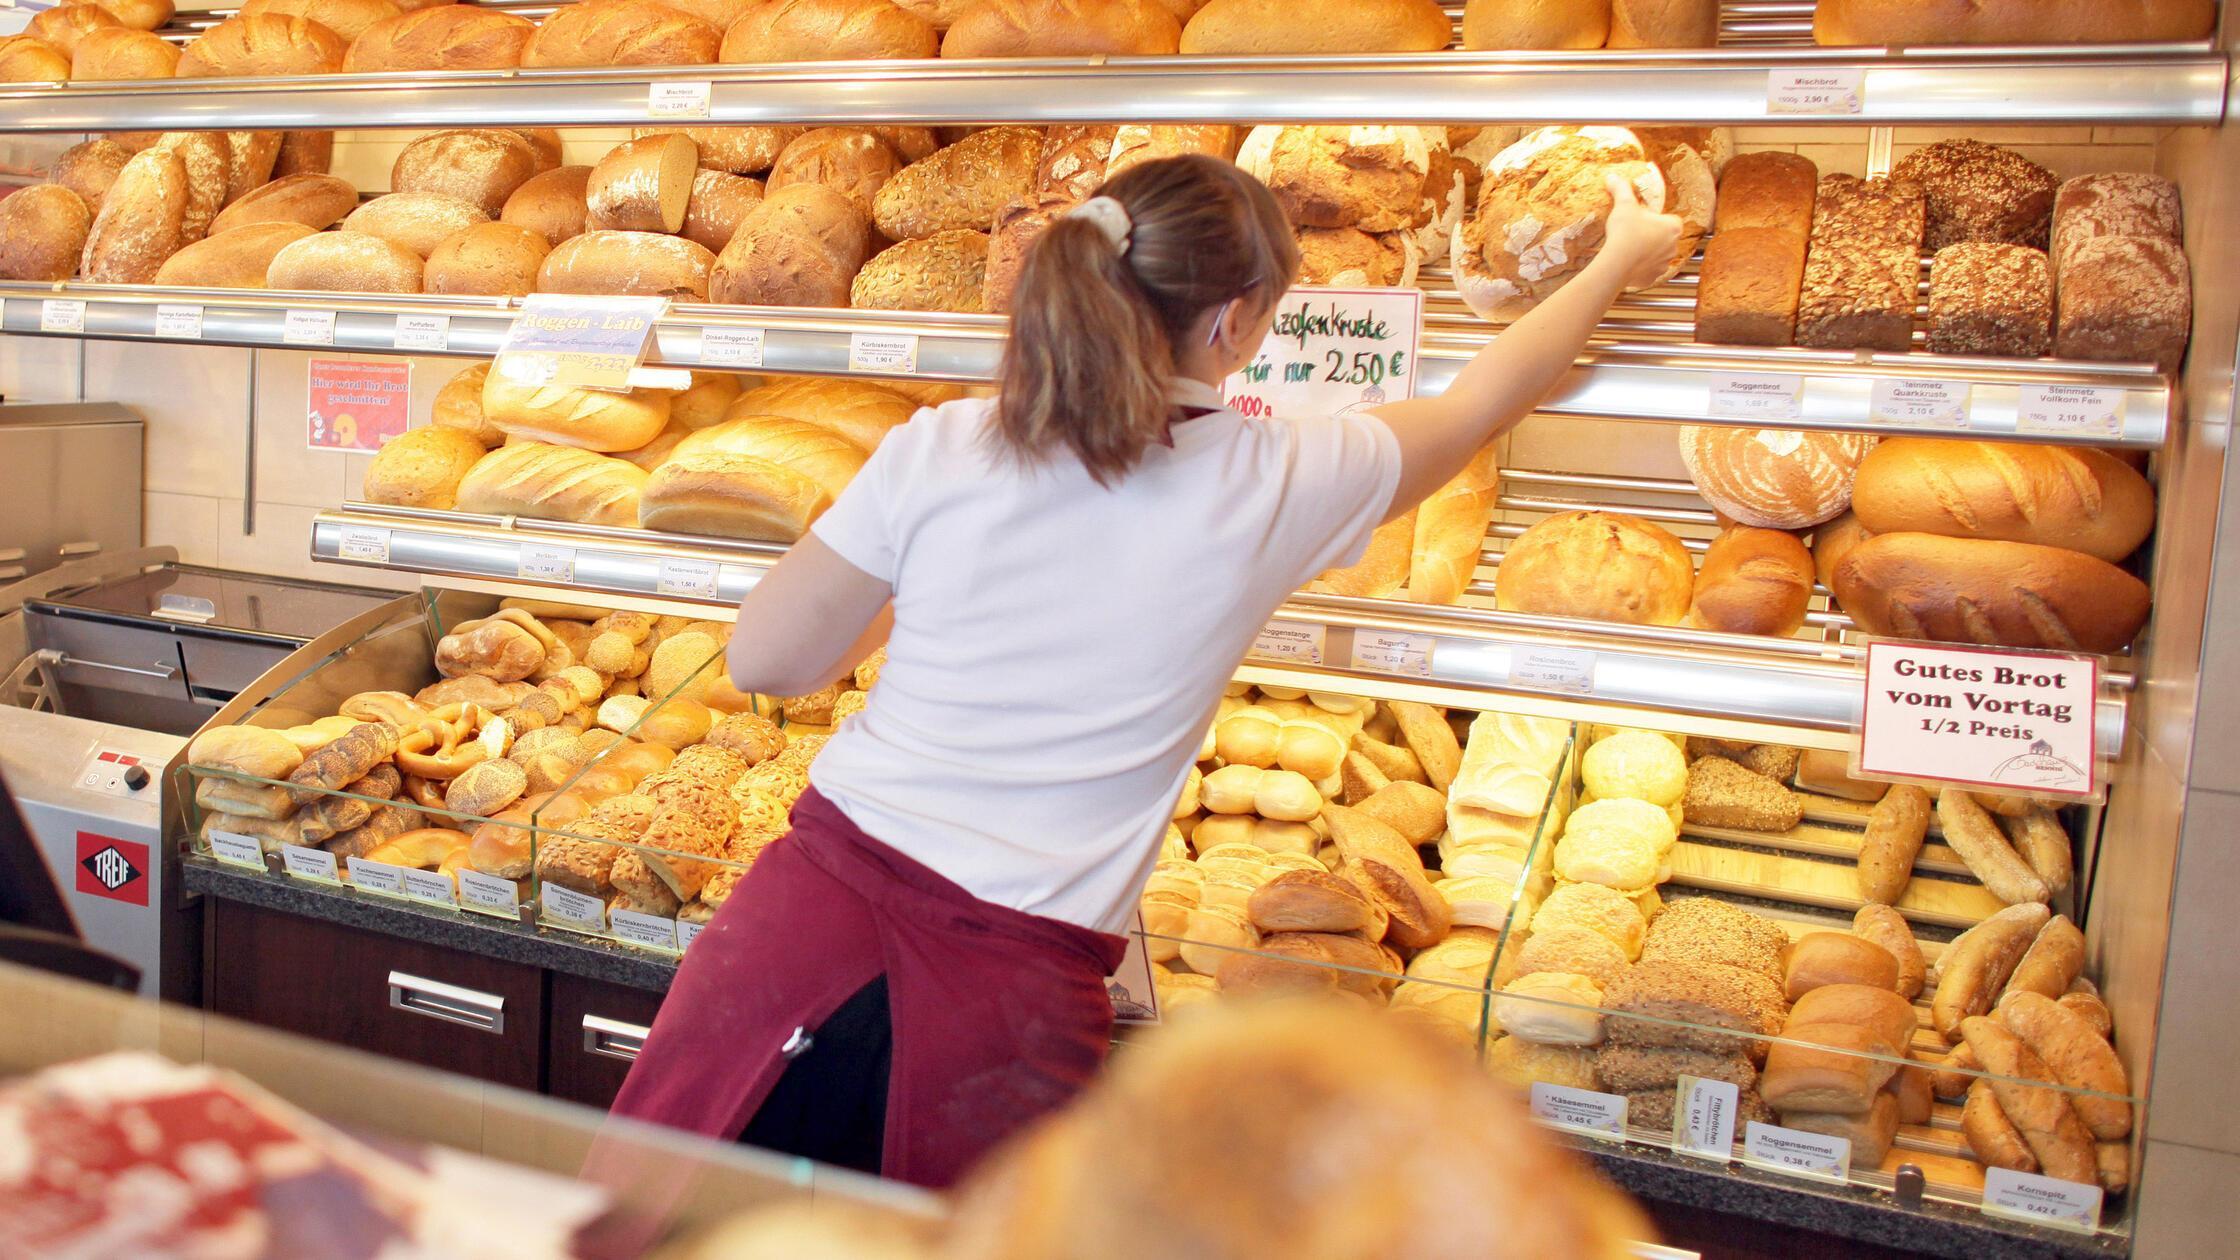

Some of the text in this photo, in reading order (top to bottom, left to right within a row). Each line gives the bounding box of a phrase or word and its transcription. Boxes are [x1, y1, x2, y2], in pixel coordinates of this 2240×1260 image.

[523, 313, 593, 332] Roggen
[600, 315, 646, 330] Laib
[861, 341, 906, 349] Kürbiskernbrot
[1284, 360, 1317, 384] nur
[1389, 350, 1407, 377] €
[312, 377, 408, 392] Hier wird Ihr Brot
[1731, 381, 1781, 392] Roggenbrot
[1901, 380, 1943, 389] teinmetz
[2048, 385, 2095, 396] Steinmetz
[1893, 389, 1948, 398] Quarkkruste
[2040, 394, 2102, 405] Vollkorn Fein
[1908, 407, 1926, 415] 2,10
[1927, 408, 1935, 416] €
[2058, 414, 2078, 423] 2,10
[2079, 414, 2086, 423] €
[1260, 627, 1311, 639] Roggenstange
[1276, 644, 1291, 653] 1,20
[1291, 645, 1297, 653] €
[1399, 656, 1406, 664] €
[1559, 673, 1565, 681] €
[1893, 658, 2067, 689] Gutes Brot
[1885, 689, 2073, 723] vom Vortag
[1920, 718, 2034, 741] 1/2 Preis
[94, 847, 130, 889] TREIF
[1551, 1095, 1606, 1112] Käsesemmel
[1567, 1114, 1585, 1124] 0,45
[1586, 1118, 1592, 1126] €
[1761, 1134, 1833, 1155] Roggensemmel
[1784, 1156, 1803, 1166] 0,38
[1805, 1160, 1812, 1168] €
[2017, 1183, 2067, 1200] Kornspitz
[2027, 1203, 2048, 1215] 0,42
